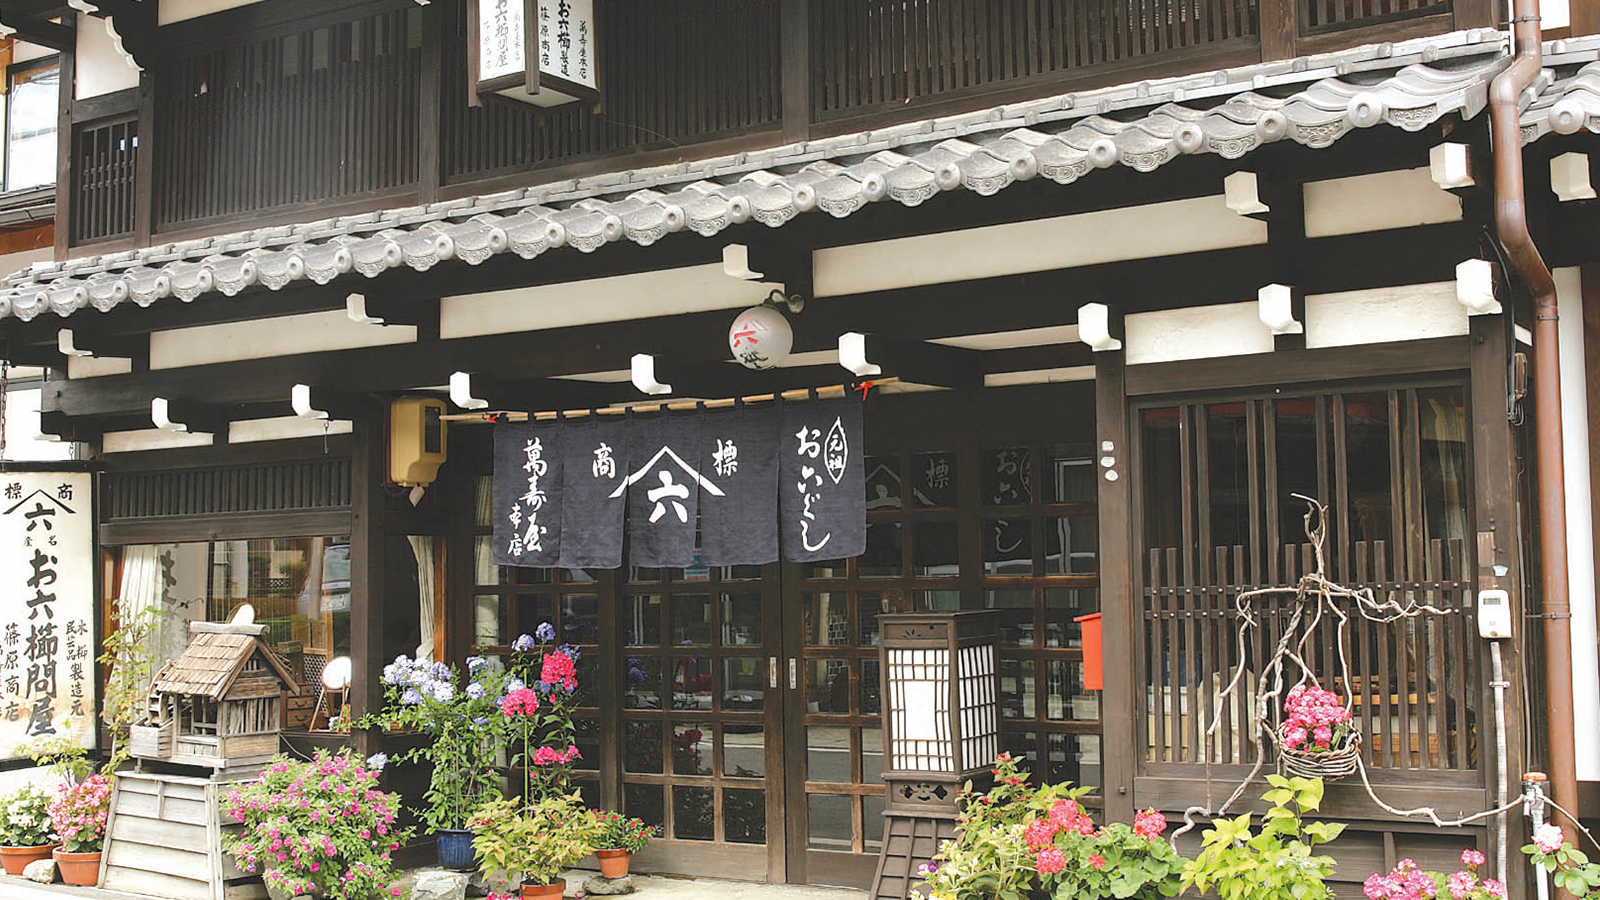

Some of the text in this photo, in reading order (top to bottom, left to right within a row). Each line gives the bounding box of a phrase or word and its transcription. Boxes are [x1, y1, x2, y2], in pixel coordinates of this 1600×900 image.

[591, 442, 616, 479] 商
[712, 438, 739, 477] 標
[829, 434, 843, 470] 元祖
[4, 481, 23, 500] 標
[57, 483, 73, 500] 商
[647, 469, 690, 524] 六
[24, 501, 56, 532] 六
[22, 548, 59, 737] お六櫛問屋
